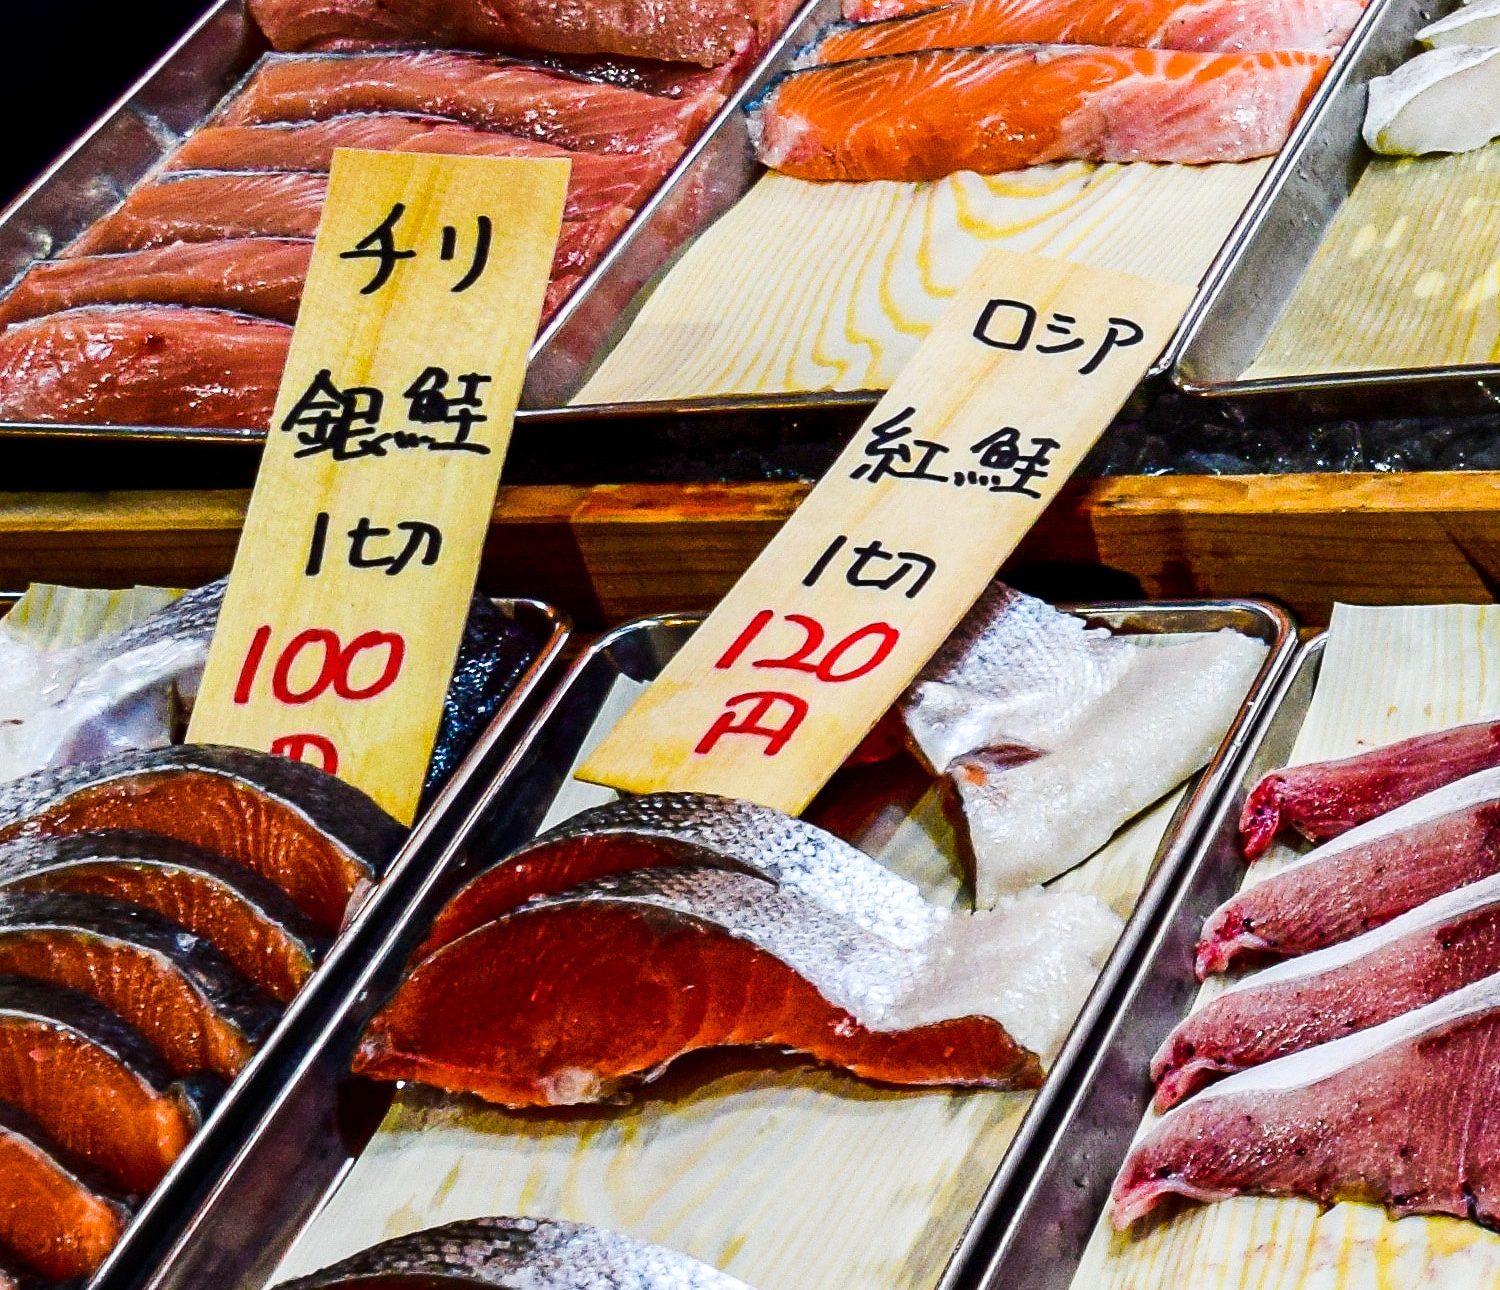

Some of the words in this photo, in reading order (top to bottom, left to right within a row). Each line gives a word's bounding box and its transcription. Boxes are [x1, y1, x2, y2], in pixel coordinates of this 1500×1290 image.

[340, 201, 493, 295] チリ
[973, 298, 1144, 375] ロシア
[280, 365, 493, 460] 銀鮭
[849, 407, 1062, 499] 紅鮭
[305, 513, 441, 575] 1切
[802, 535, 937, 599] 1切
[234, 626, 405, 706] 100
[714, 609, 900, 682] 120
[694, 690, 810, 755] 円
